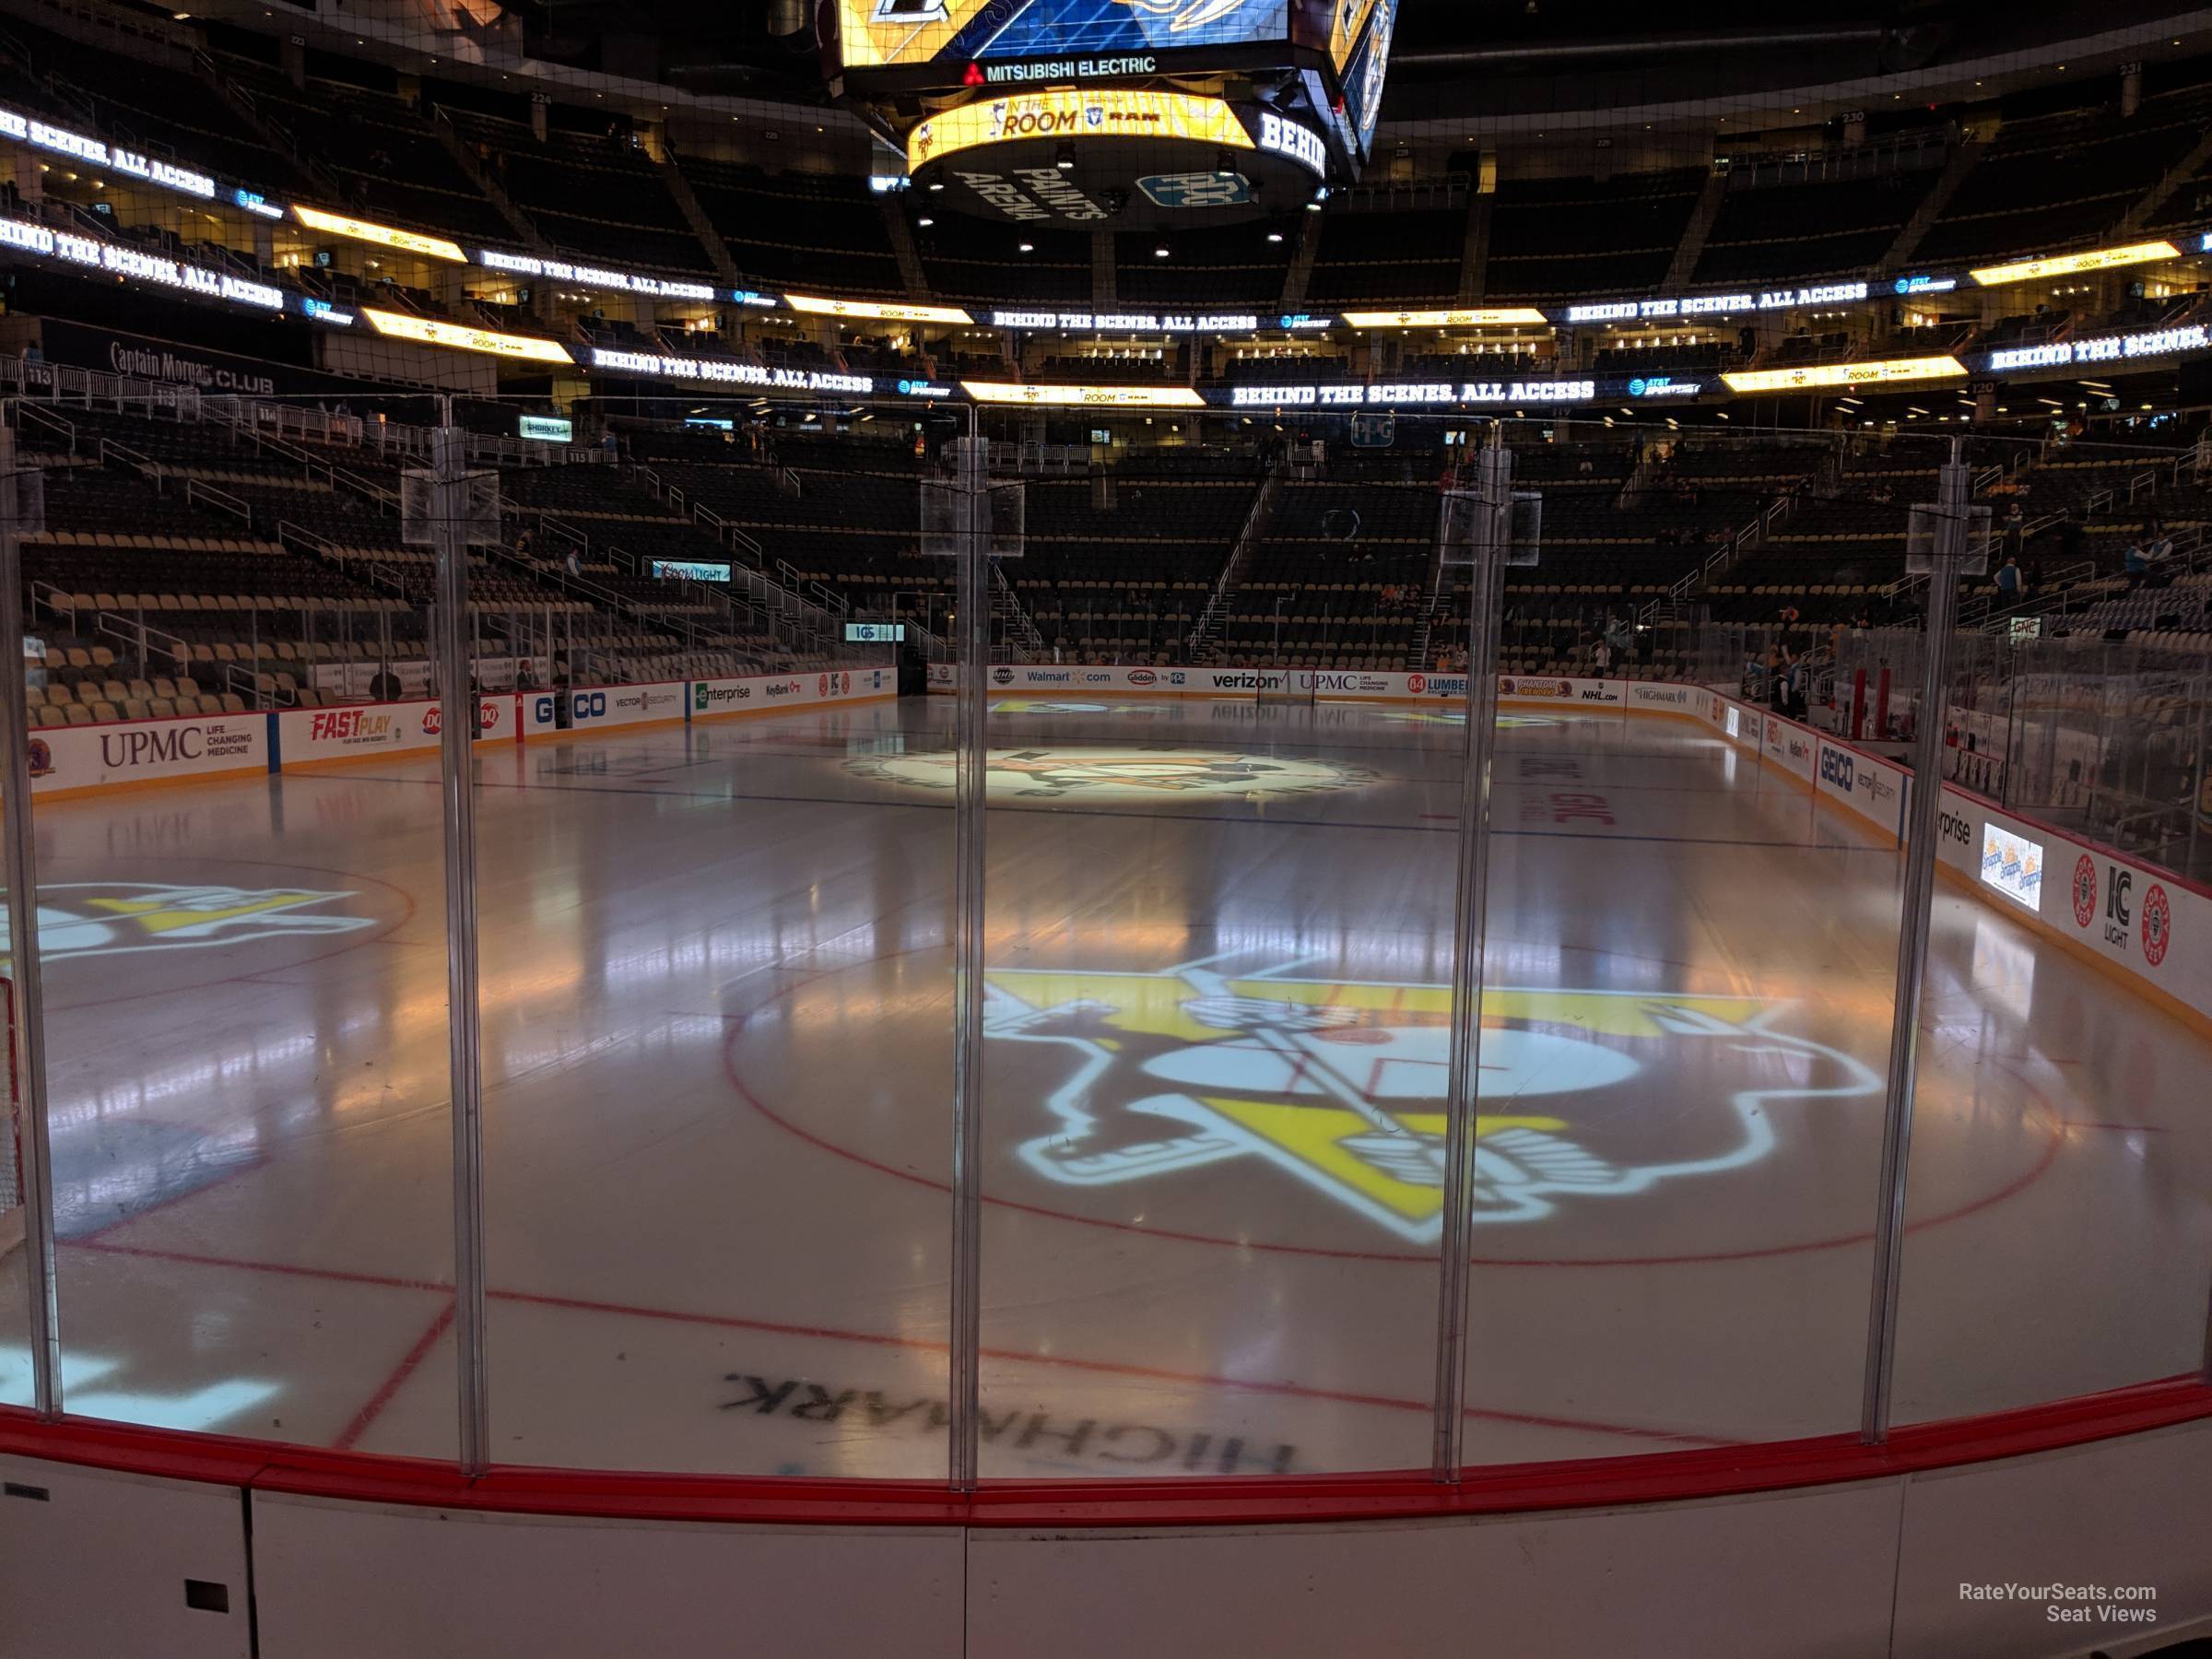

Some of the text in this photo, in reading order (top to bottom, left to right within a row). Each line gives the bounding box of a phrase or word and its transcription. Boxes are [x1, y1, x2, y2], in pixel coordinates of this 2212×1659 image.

[987, 56, 1156, 81] MITSUBISHI ELECTRIC
[532, 92, 552, 105] 224
[1003, 111, 1077, 136] ROOM
[1109, 112, 1161, 122] RAM
[1842, 112, 1865, 123] 230
[29, 120, 112, 166] SCENES,
[112, 147, 150, 178] ALL
[151, 160, 215, 197] ACCESS
[953, 171, 1053, 221] ARENA
[1013, 168, 1109, 221] PAINTS
[56, 233, 100, 265] THE
[103, 246, 182, 287] SCENES,
[183, 266, 220, 293] ALL
[221, 276, 283, 309] ACCESS
[632, 275, 659, 293] ALL
[660, 281, 714, 300] ACCESS
[1569, 302, 1638, 321] BEHIND
[1641, 300, 1677, 316] THE
[1759, 291, 1795, 309] ALL
[1797, 283, 1867, 305] ACCESS
[880, 310, 904, 318] ROOM
[994, 312, 1056, 327] BEHIND
[1059, 314, 1092, 328] THE
[1162, 316, 1194, 330] ALL
[1196, 316, 1257, 330] ACCESS
[1446, 315, 1473, 324] ROOM
[472, 337, 497, 348] ROOM
[1991, 325, 2208, 370] BEHIND THE SCENES,
[111, 341, 160, 378] Captain
[216, 370, 275, 394] CLUB
[594, 348, 660, 372] BEHIND
[662, 358, 698, 377] THE
[775, 370, 809, 388] ALL
[809, 372, 874, 392] ACCESS
[1847, 371, 1878, 381] ROOM
[29, 368, 51, 385] 113
[1646, 378, 1671, 386] AT&T
[1083, 394, 1116, 403] ROOM
[1233, 381, 1595, 405] BEHIND THE SCENES, ALL ACCESS
[695, 567, 722, 581] LIGHT
[1027, 671, 1111, 683] Walmart com
[1127, 673, 1157, 683] Glidden
[1212, 672, 1279, 690] verizon
[1299, 675, 1358, 691] UPMC
[1408, 677, 1467, 690] 84 LUMBE
[699, 685, 750, 702] enterprise
[766, 685, 789, 698] KeyBank
[616, 698, 641, 708] VECTOR
[206, 724, 225, 735] LIFE
[311, 710, 392, 741] FAST PLAY
[100, 726, 202, 769] UPMC
[206, 734, 253, 746] CHANGING
[206, 745, 249, 757] MEDICINE
[1821, 746, 1853, 793] GEICO
[2106, 865, 2132, 926] IC
[2104, 923, 2129, 951] LIGHT
